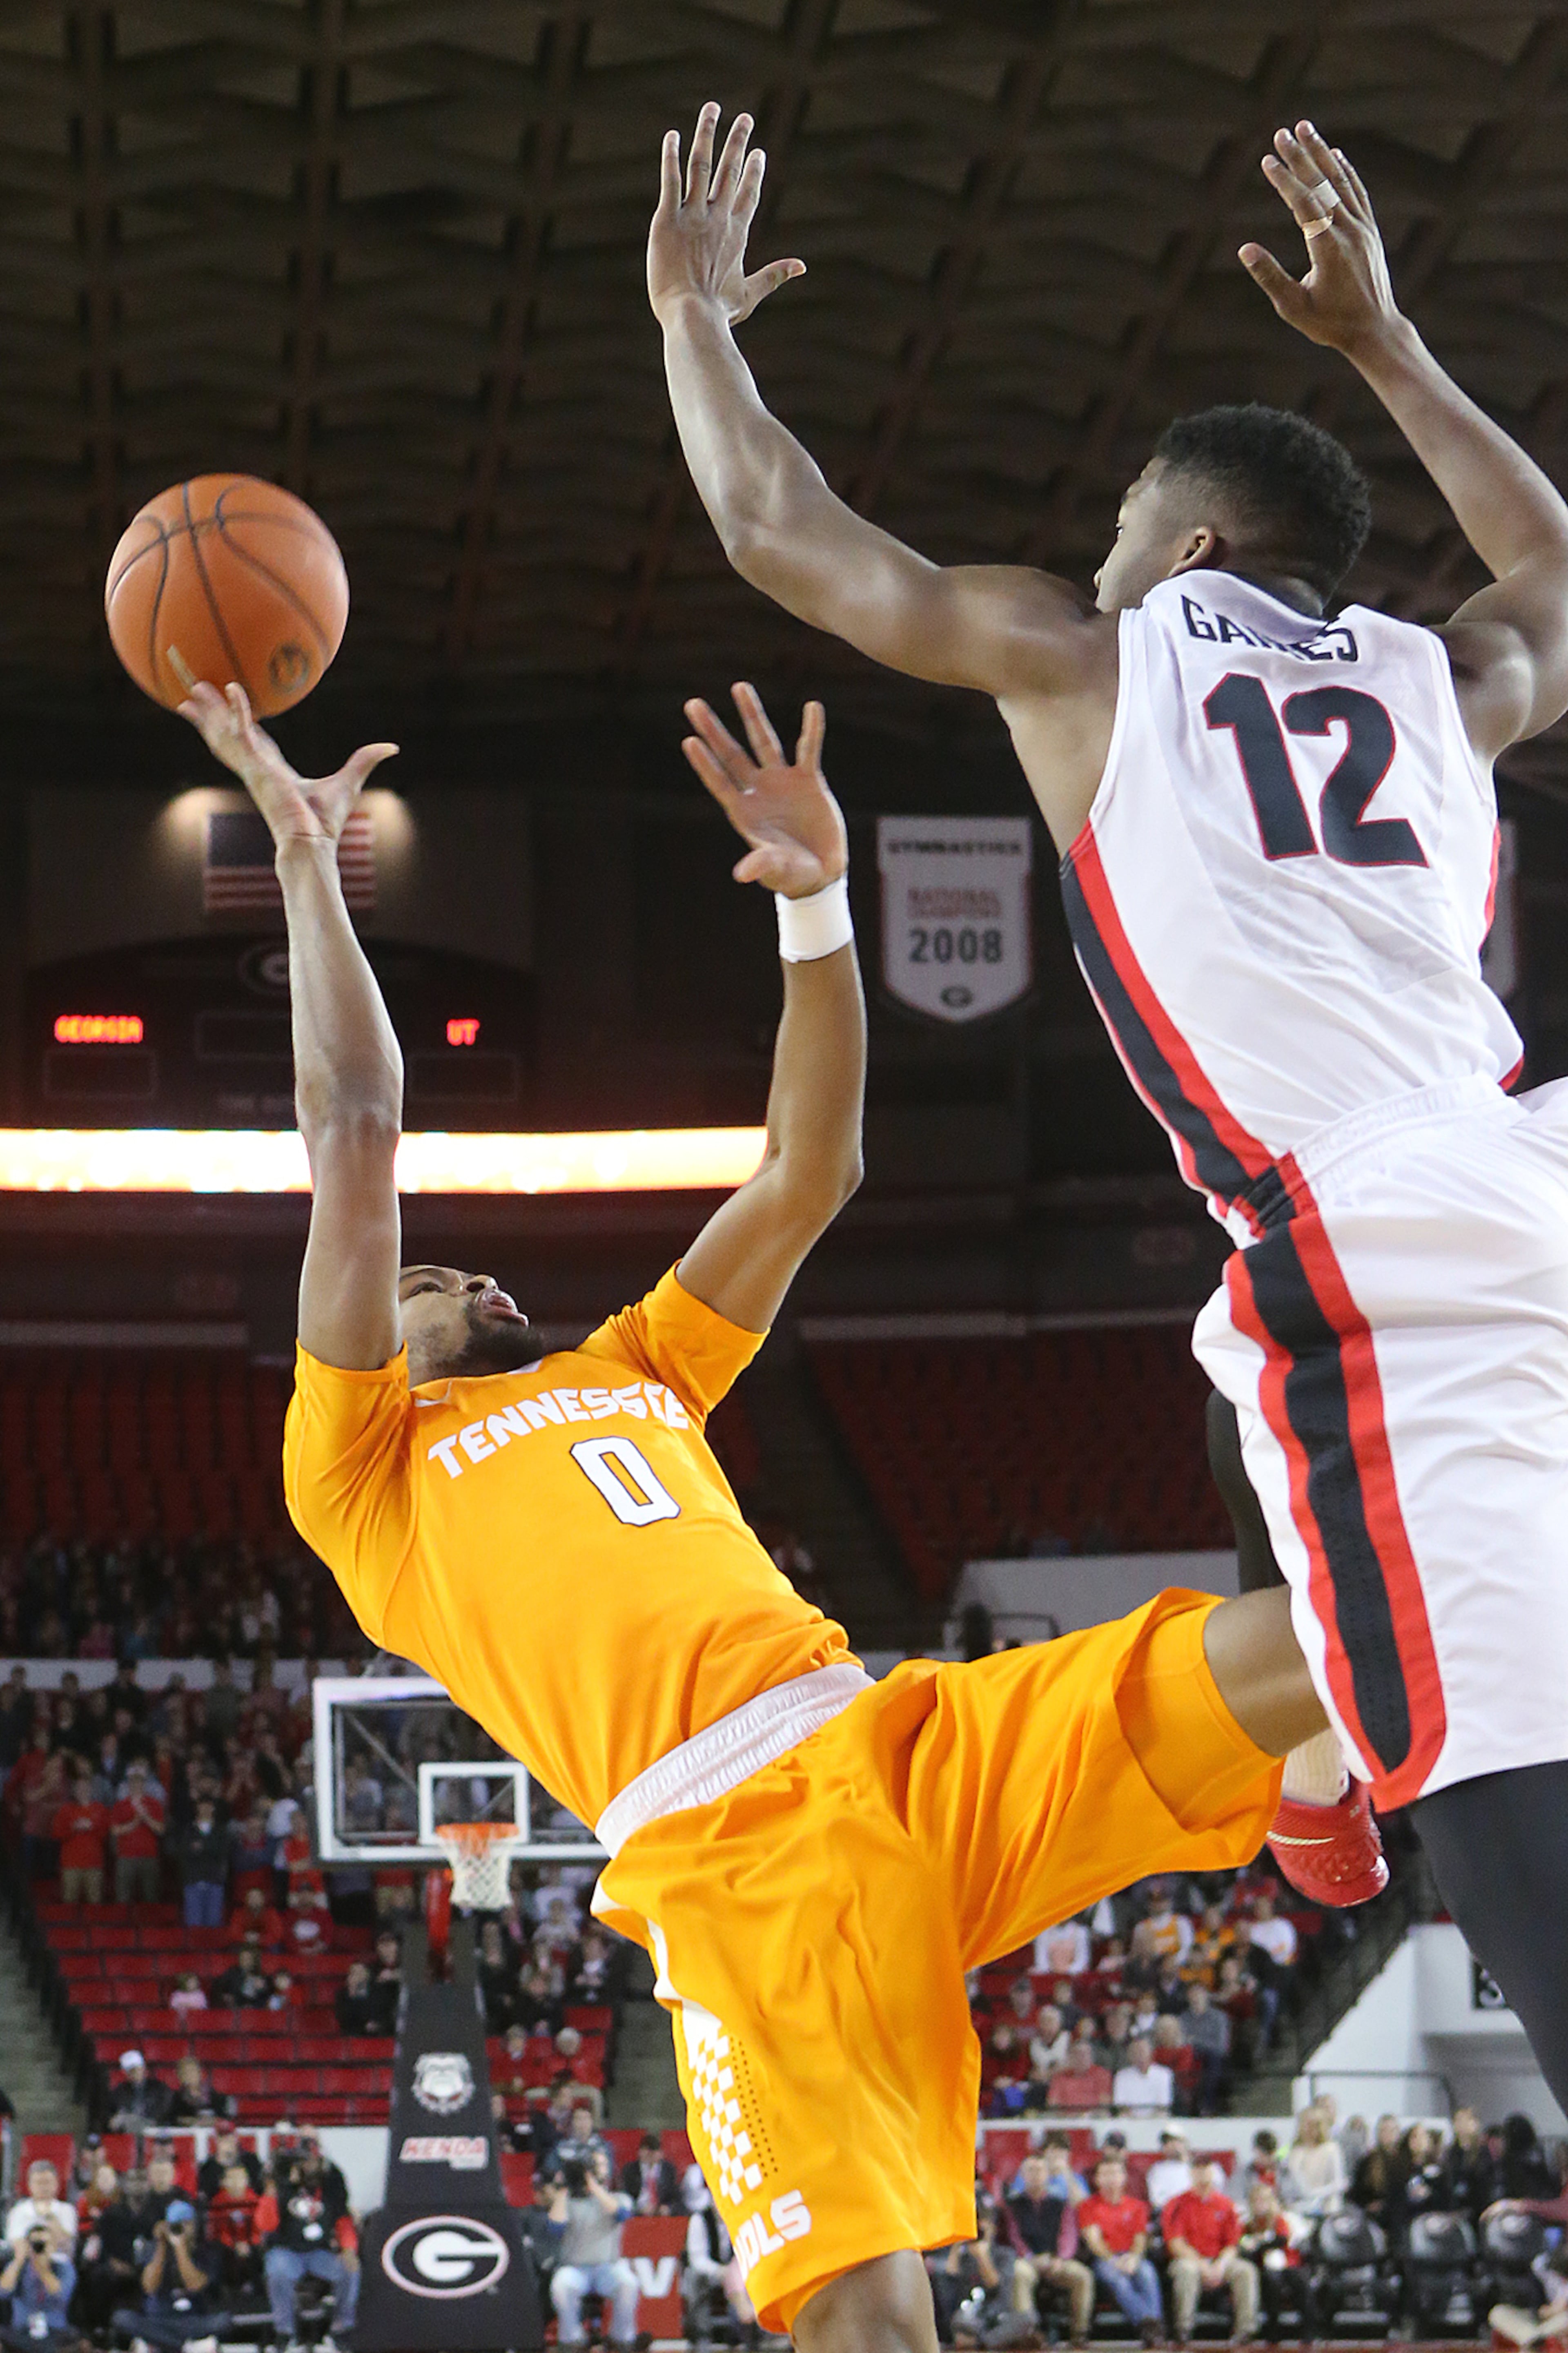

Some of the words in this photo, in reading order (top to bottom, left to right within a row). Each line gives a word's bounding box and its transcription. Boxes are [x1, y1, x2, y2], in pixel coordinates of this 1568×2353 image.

[1181, 594, 1358, 662] GAIES
[1202, 671, 1429, 868] 12
[908, 927, 1003, 963] 2008
[54, 1014, 143, 1044] GEORGIA
[446, 1017, 481, 1046] UT
[569, 1436, 682, 1527] 0
